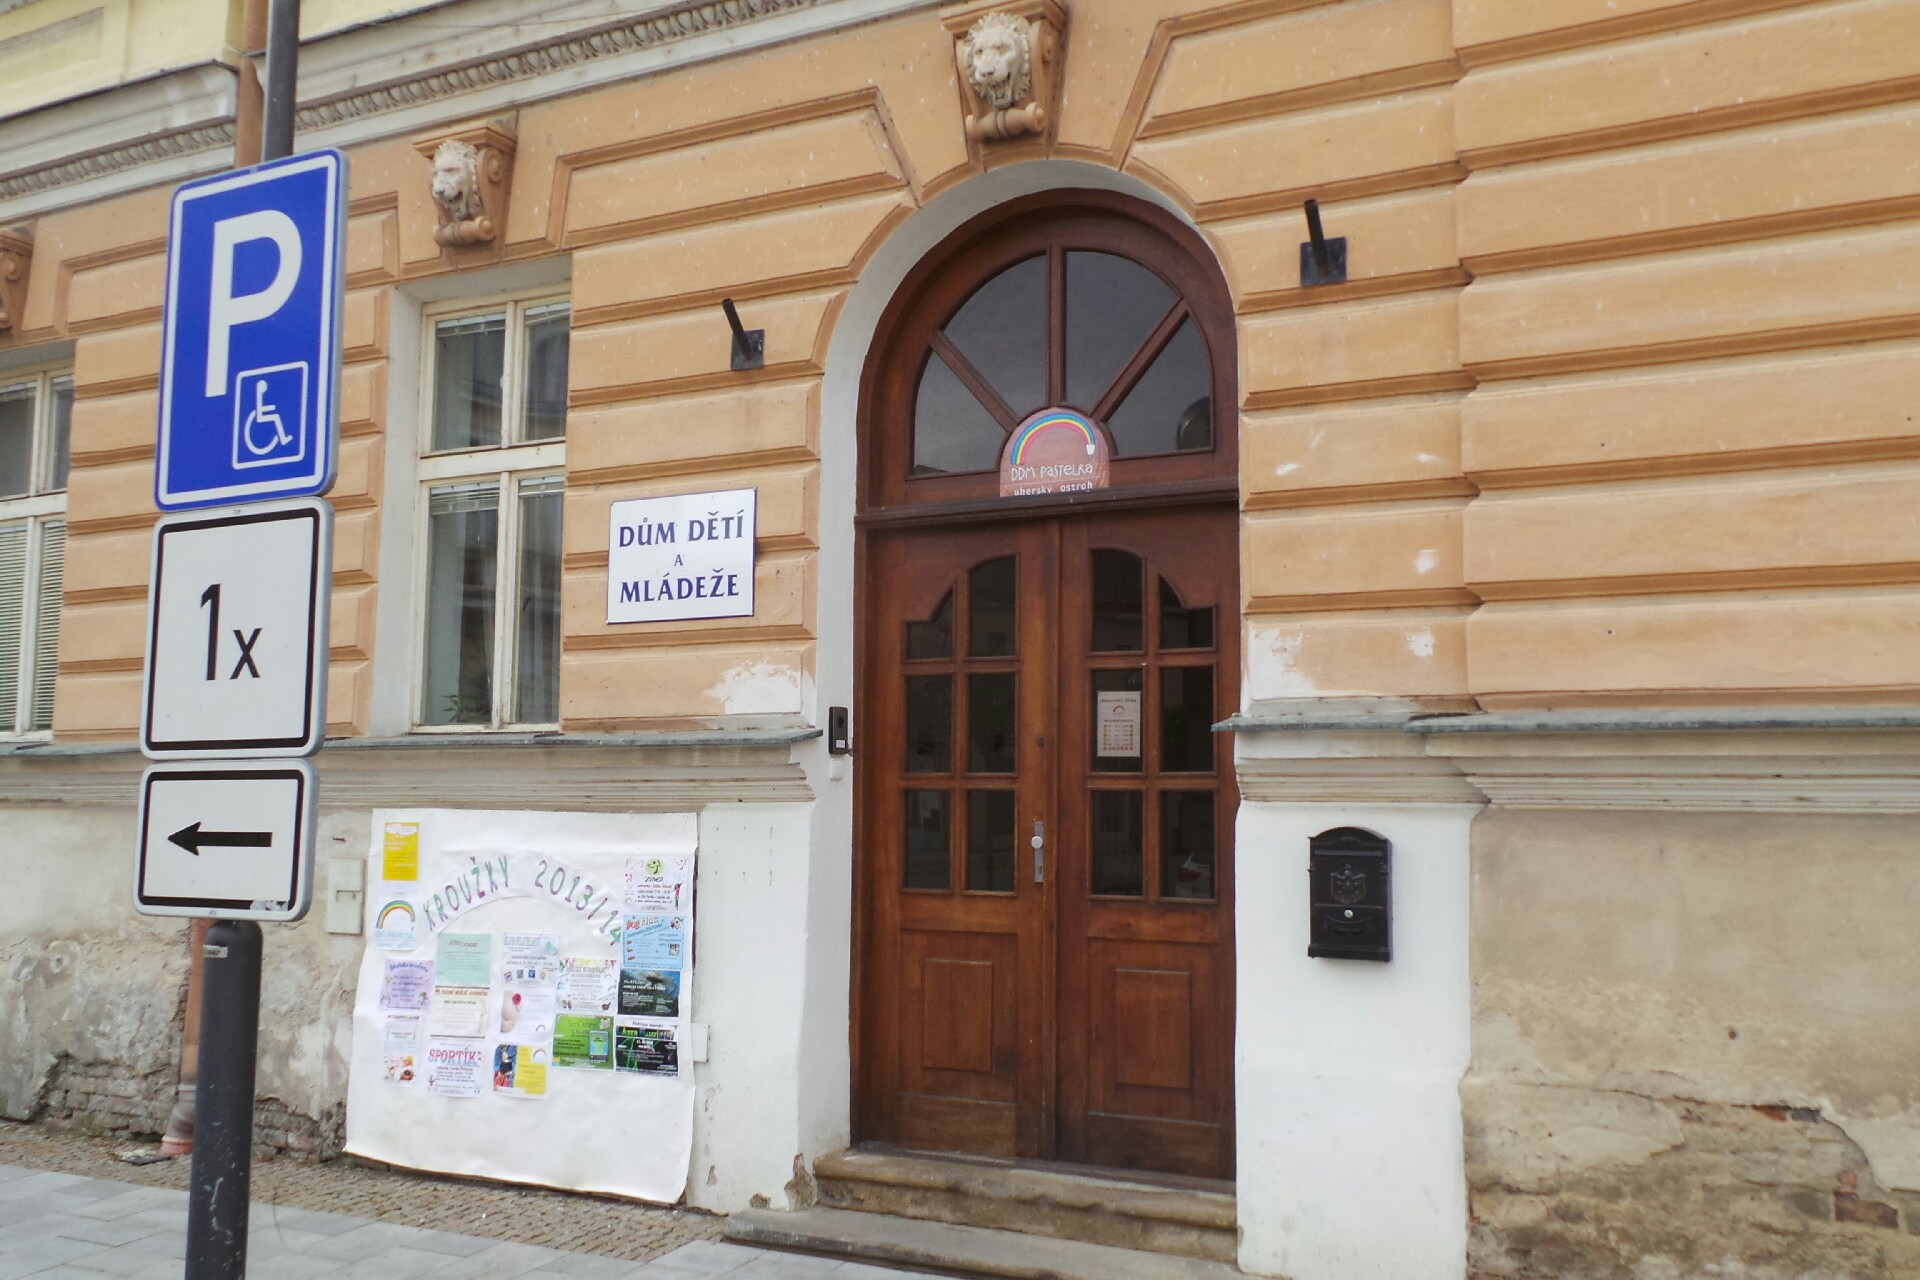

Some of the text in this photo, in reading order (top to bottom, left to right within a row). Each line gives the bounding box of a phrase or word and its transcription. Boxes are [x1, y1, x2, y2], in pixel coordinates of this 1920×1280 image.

[205, 209, 303, 398] P
[1011, 466, 1036, 481] DDM
[1060, 480, 1093, 492] ostroh
[618, 509, 745, 548] DŮM DĚTÍ
[673, 554, 684, 567] A
[619, 568, 740, 604] MLÁDEŽE
[423, 855, 509, 931] KROUŽKY
